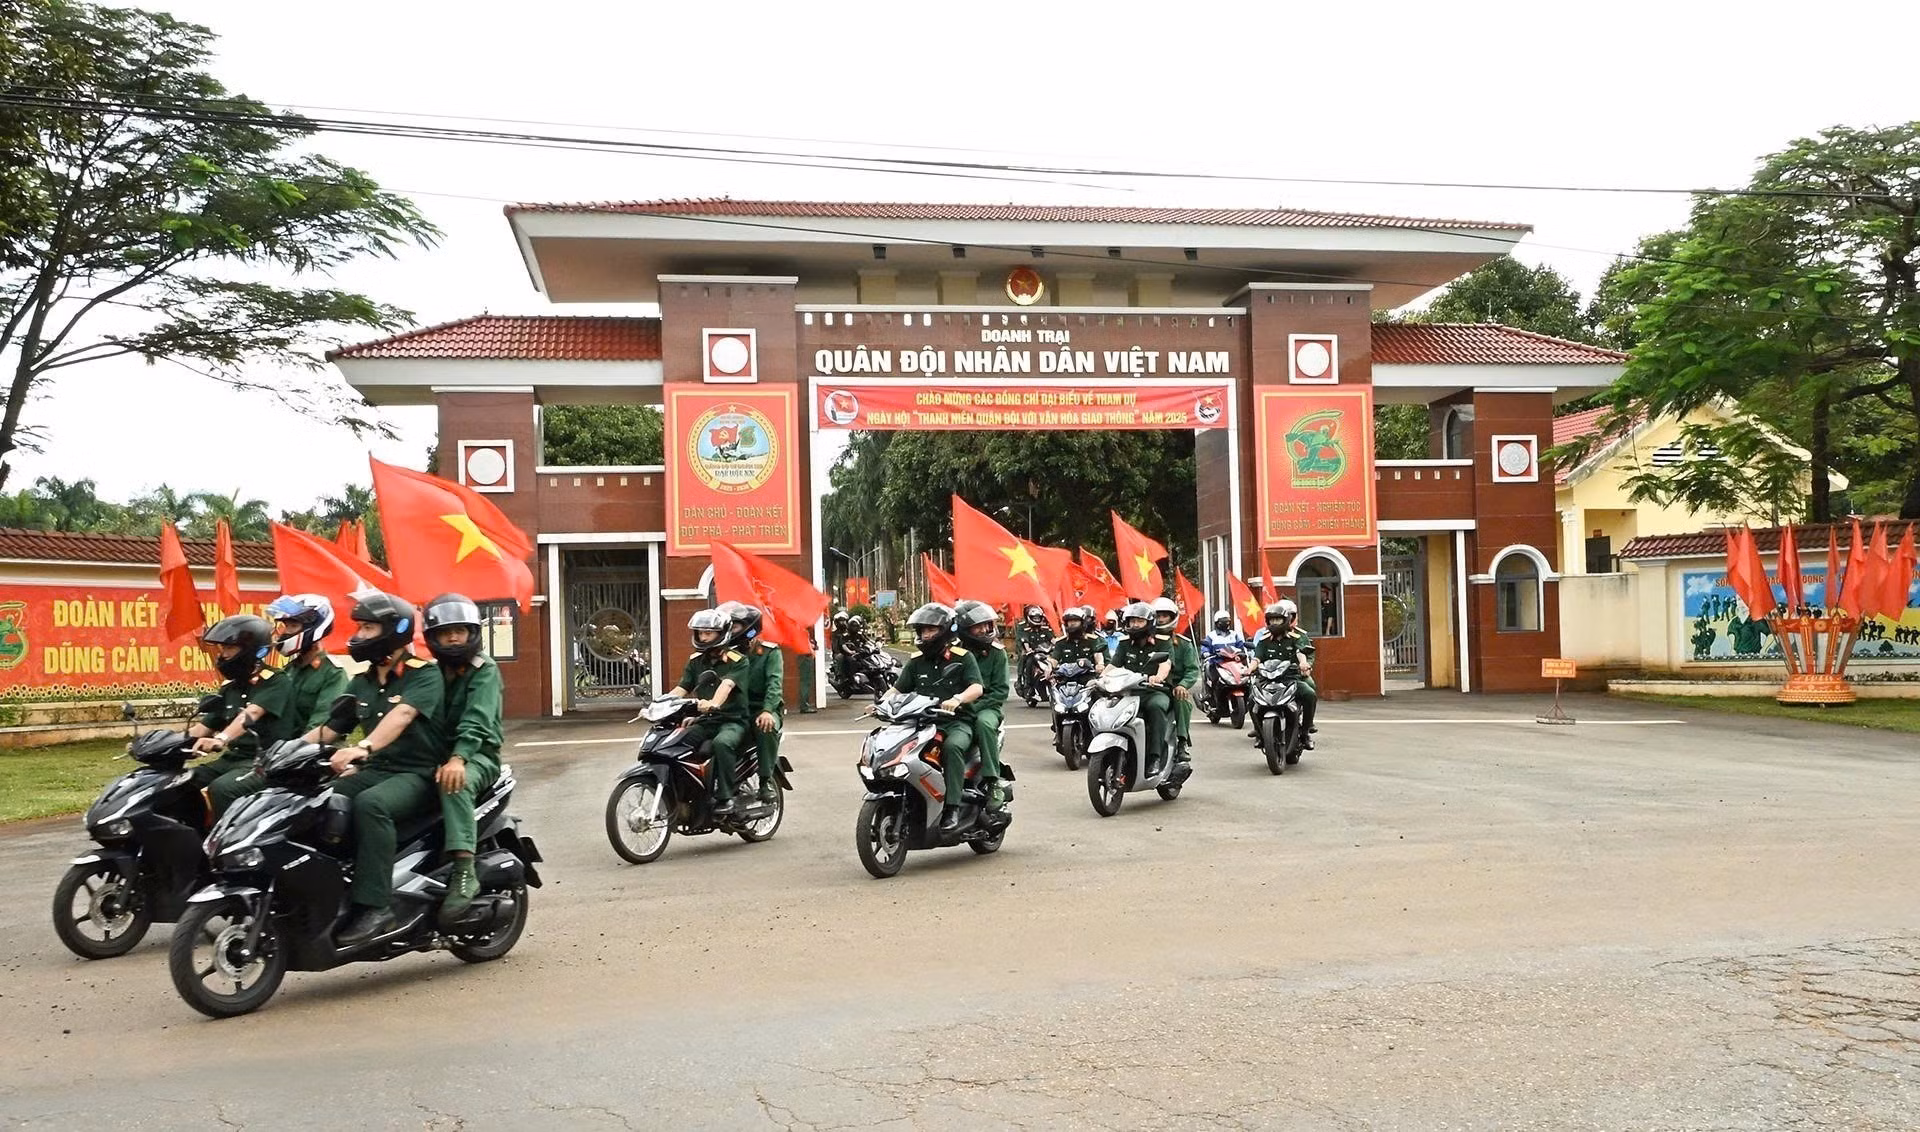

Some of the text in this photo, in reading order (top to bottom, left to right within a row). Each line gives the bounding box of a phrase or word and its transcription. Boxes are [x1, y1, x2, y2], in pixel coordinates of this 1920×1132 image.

[981, 330, 1070, 346] DOANH TRẠI
[815, 344, 1230, 378] QUÂN ĐỘI NHÂN DÂN VIỆT NAM
[916, 391, 942, 405] CHÀO
[944, 391, 972, 405] MỪNG
[974, 391, 993, 405] CÁC
[1023, 391, 1039, 405] CHÍ
[1041, 392, 1058, 407] ĐẠI
[1096, 393, 1122, 405] THAM
[867, 412, 892, 425] NGÀY
[894, 411, 910, 427] HỘI
[951, 411, 974, 425] NIÊN
[976, 411, 1003, 425] QUÂN
[1004, 410, 1020, 426] ĐỘI
[1022, 411, 1037, 425] VỚI
[1039, 410, 1058, 425] VĂN
[1081, 411, 1103, 425] GIAO
[1142, 410, 1164, 425] NĂM
[1165, 412, 1188, 425] 2025
[707, 503, 727, 519] CHỦ
[766, 503, 784, 518] KẾT
[53, 595, 115, 628] ĐOÀN
[121, 593, 160, 628] KẾT
[44, 641, 105, 674] DŨNG
[112, 638, 160, 673] CẢM
[165, 656, 174, 664] -
